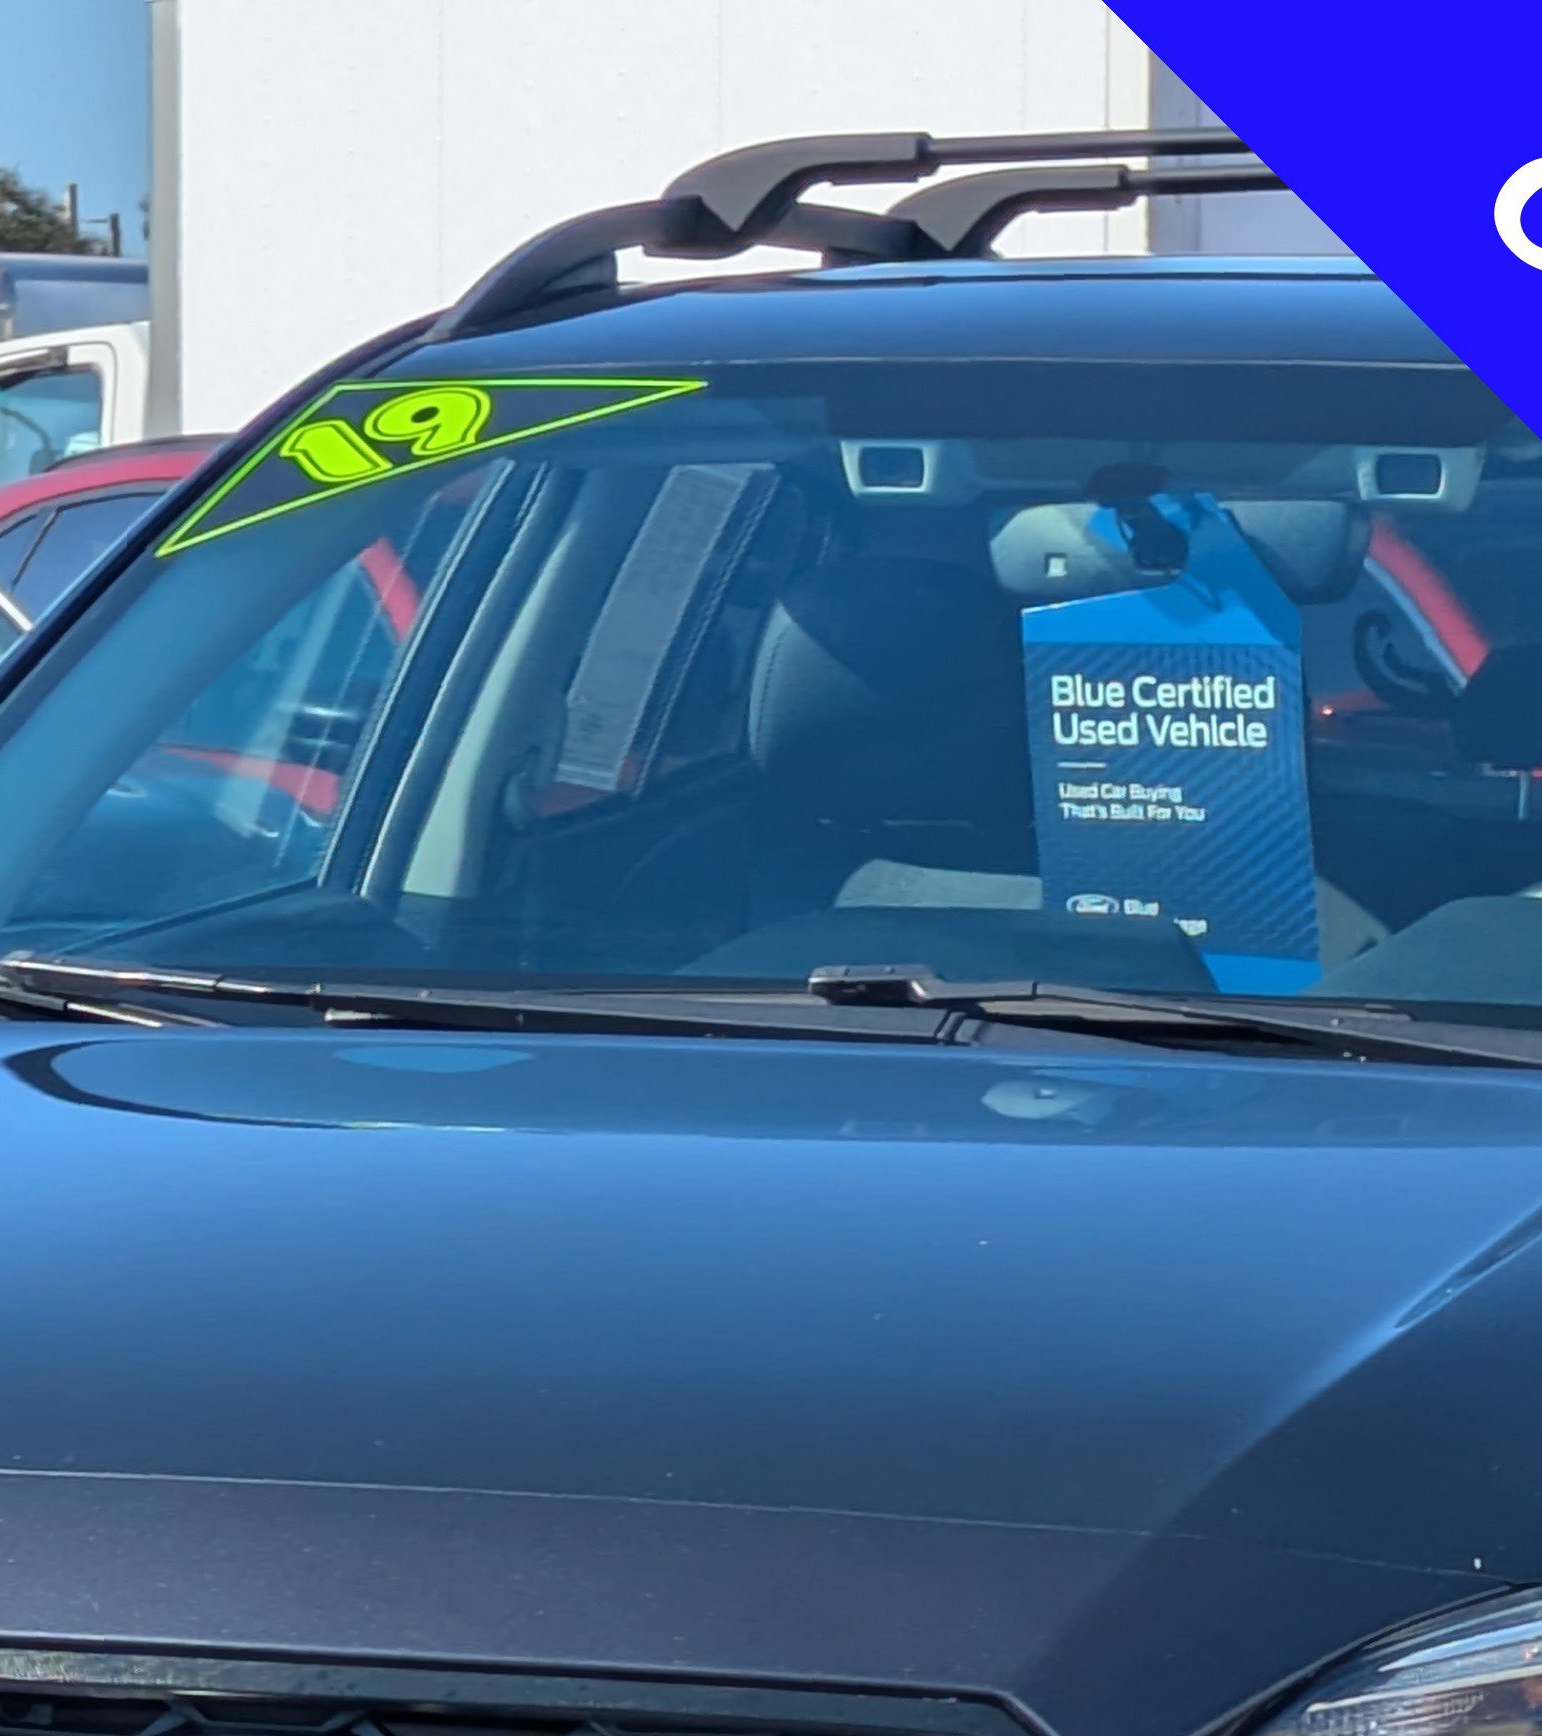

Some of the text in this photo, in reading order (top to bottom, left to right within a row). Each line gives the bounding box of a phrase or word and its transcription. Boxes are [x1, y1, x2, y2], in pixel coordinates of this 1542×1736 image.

[279, 386, 491, 482] 19
[1051, 674, 1275, 709] Blue Certified
[1053, 712, 1267, 748] Used Vehicle
[1059, 783, 1182, 804] Used Car Buying
[1147, 805, 1172, 820] For
[1174, 805, 1206, 821] You
